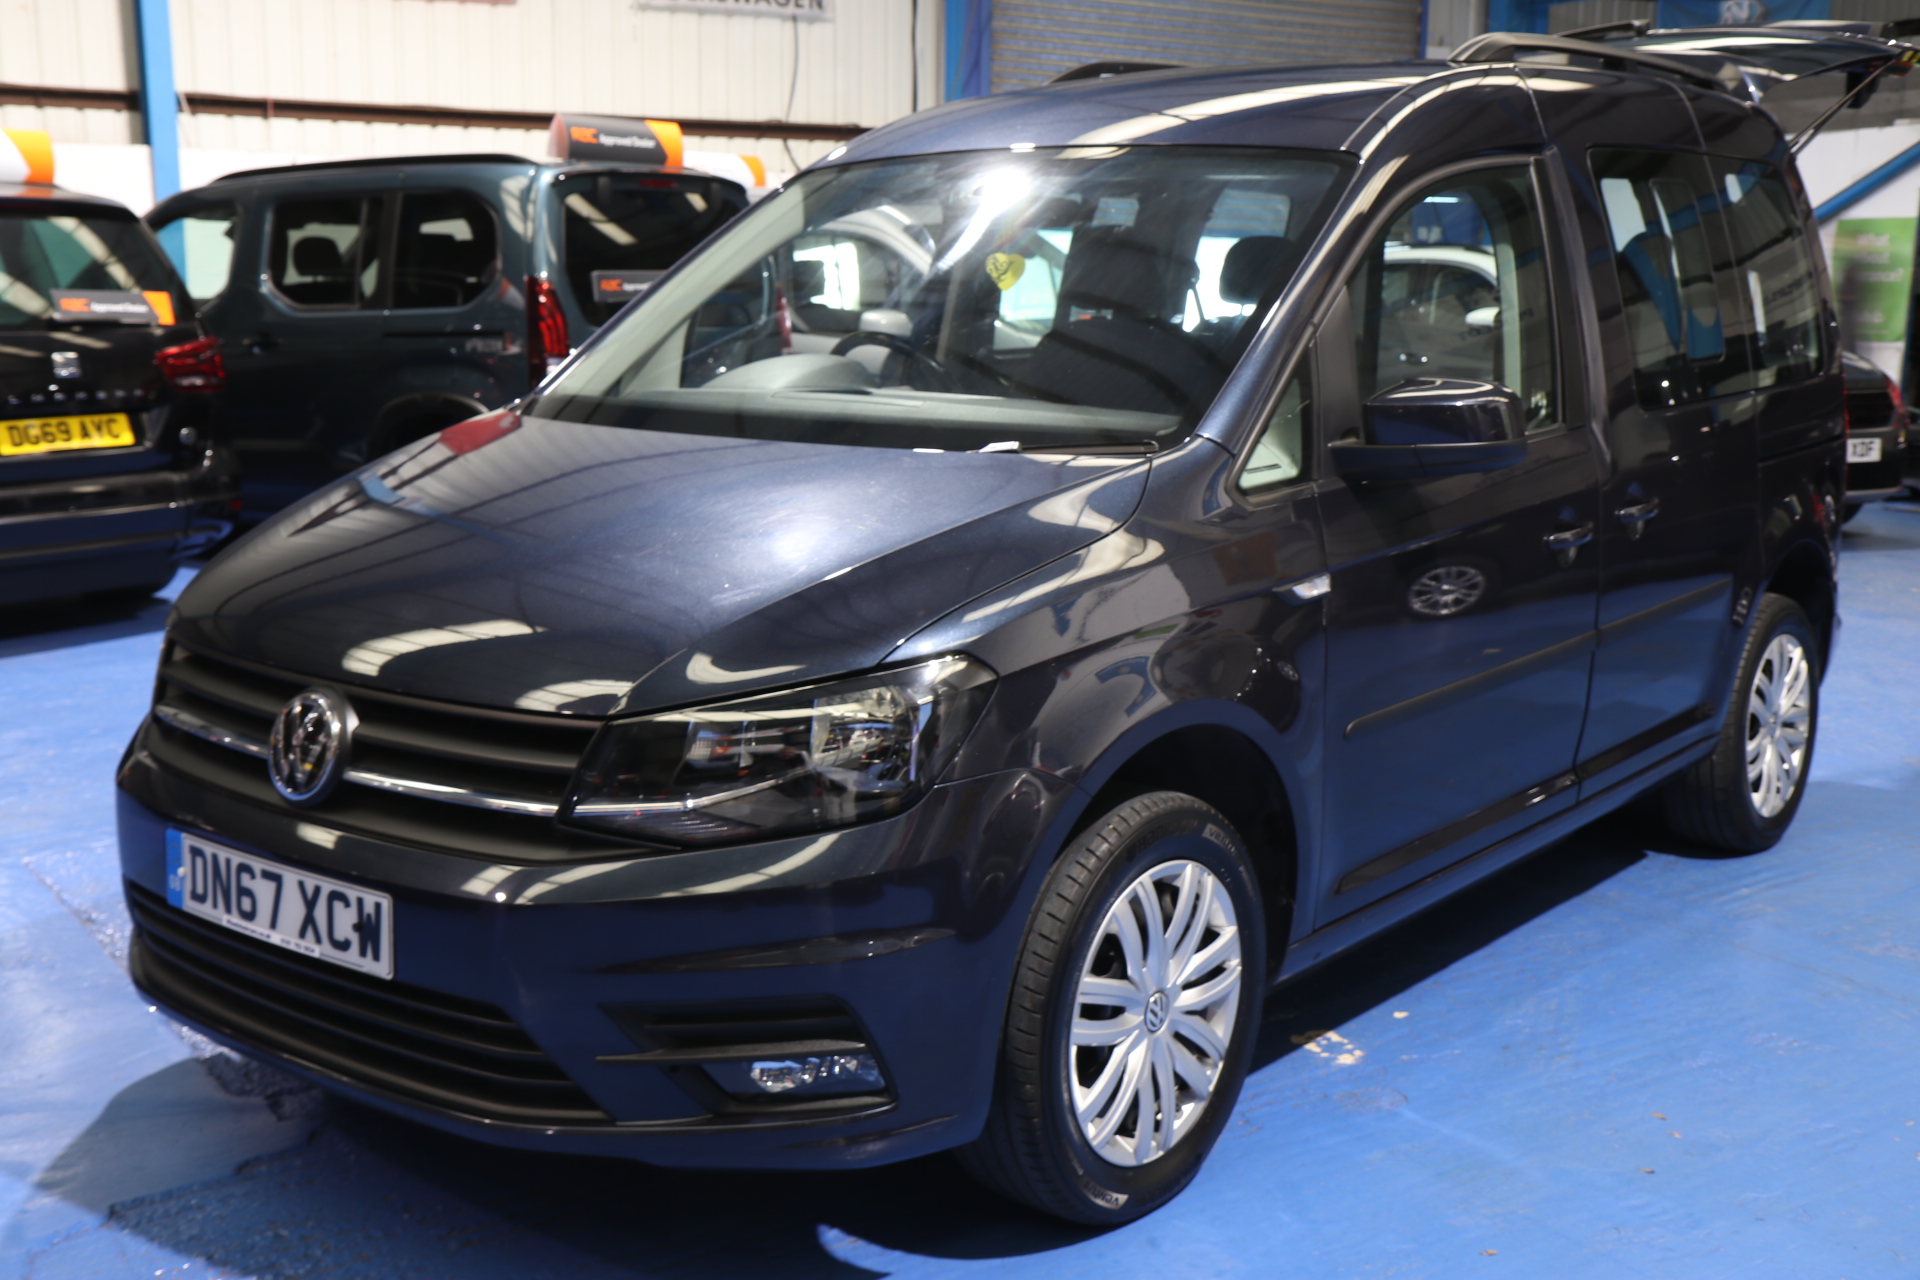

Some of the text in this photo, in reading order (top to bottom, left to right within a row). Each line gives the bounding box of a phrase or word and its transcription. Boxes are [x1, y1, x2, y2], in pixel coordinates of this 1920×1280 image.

[7, 418, 120, 447] DG69 AYC
[188, 844, 382, 963] DN67 XCW
